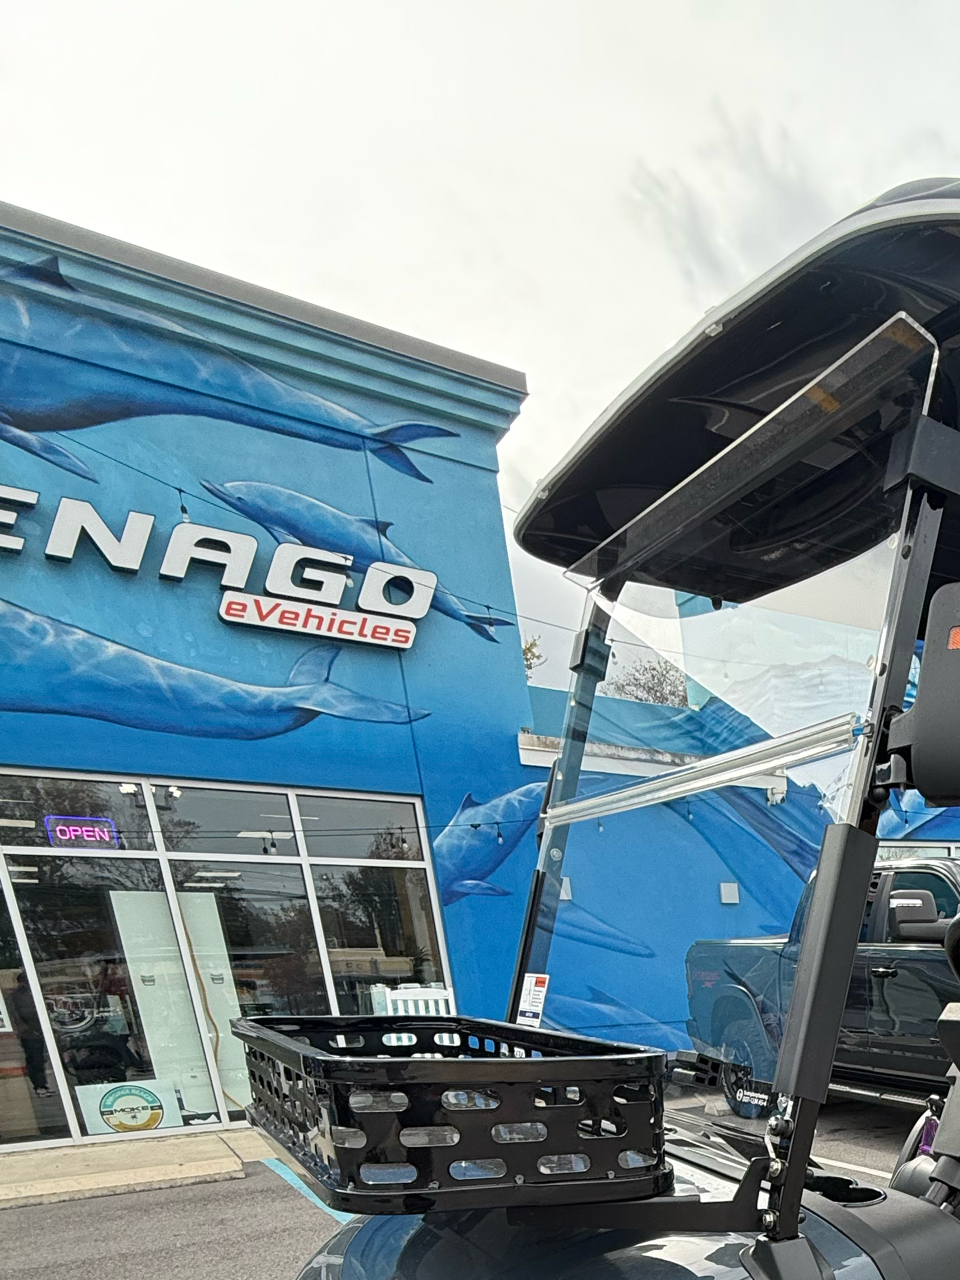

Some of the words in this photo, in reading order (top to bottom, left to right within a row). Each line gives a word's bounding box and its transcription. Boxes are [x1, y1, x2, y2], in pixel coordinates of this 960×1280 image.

[224, 598, 412, 645] eVehicles
[56, 825, 110, 841] OPEN
[105, 1089, 130, 1105] VIRGINIA
[131, 1089, 153, 1102] BEACH
[114, 1105, 150, 1114] MOKE
